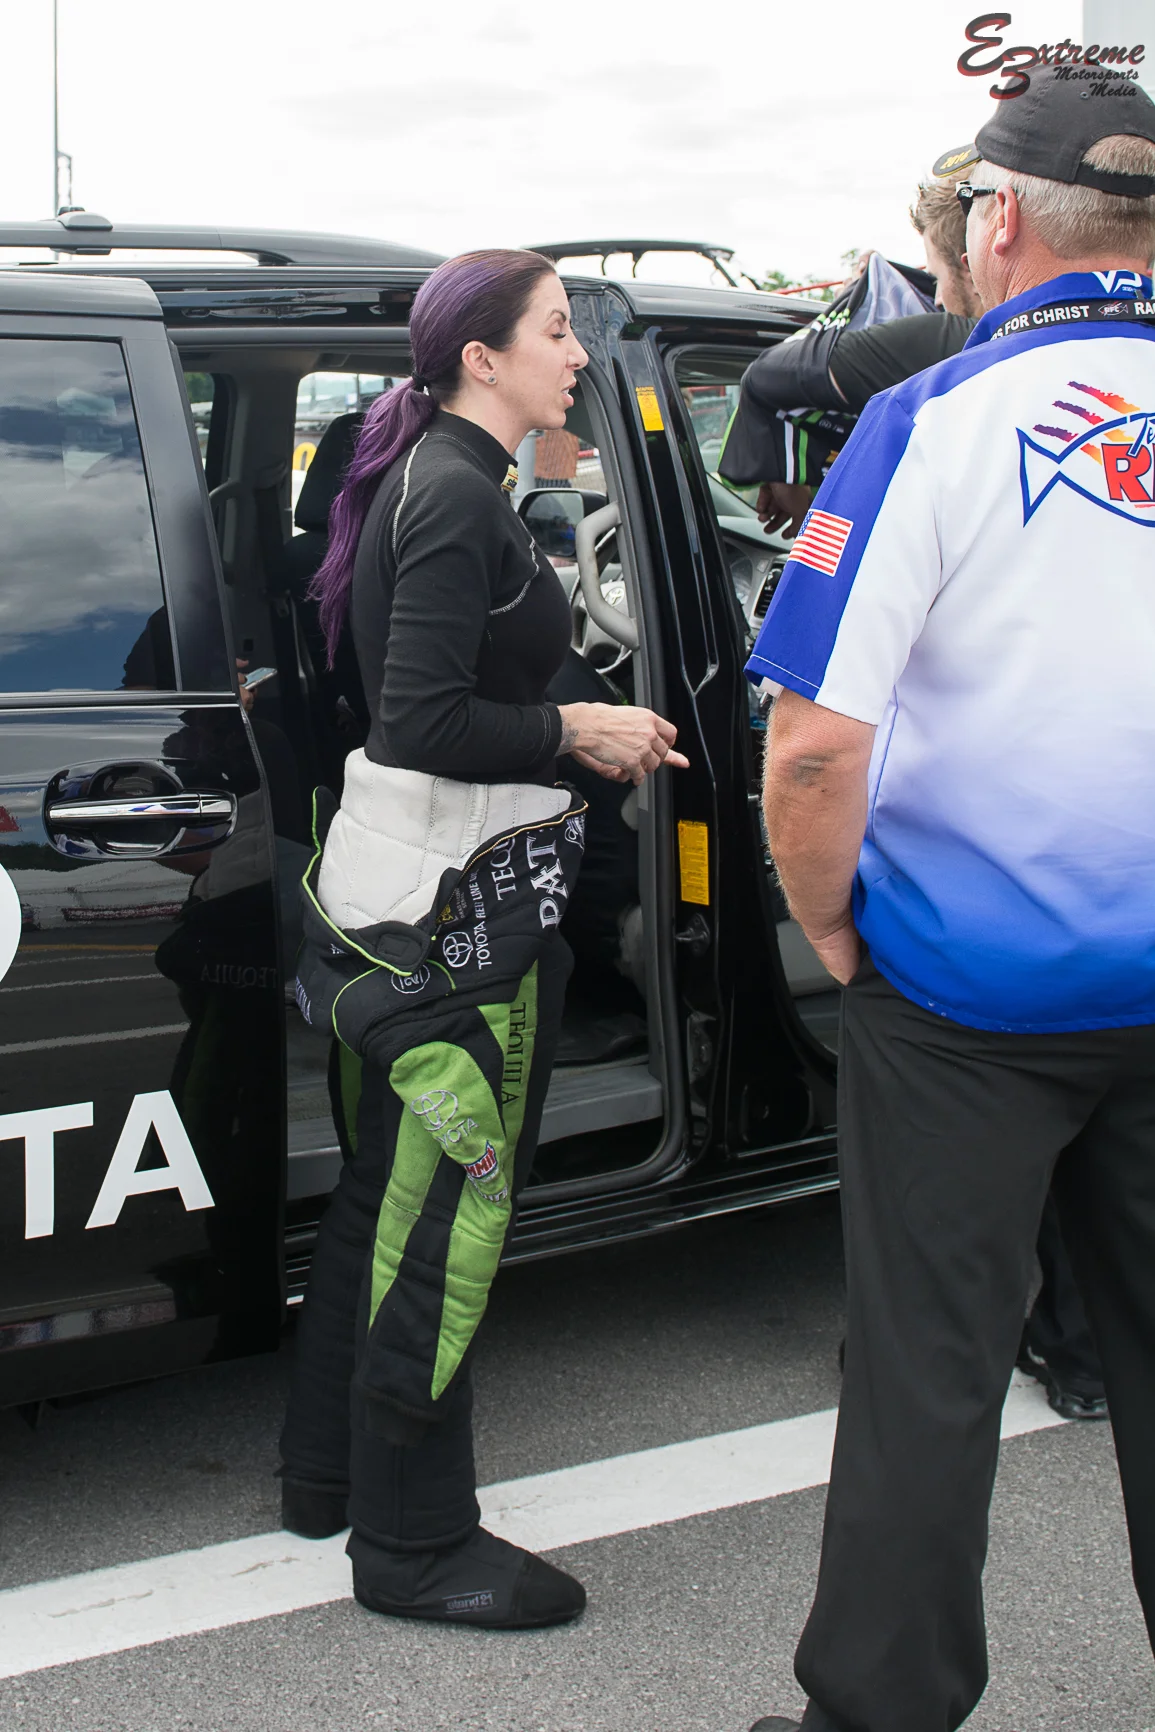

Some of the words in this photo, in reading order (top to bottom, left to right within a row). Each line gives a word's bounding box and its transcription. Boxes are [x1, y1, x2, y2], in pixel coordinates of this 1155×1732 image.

[1004, 314, 1030, 335] FOR
[1032, 305, 1090, 325] CHRIST
[1101, 443, 1155, 503] R
[526, 828, 569, 930] PAT
[474, 920, 492, 970] TOYOTA
[0, 1089, 215, 1240] TA
